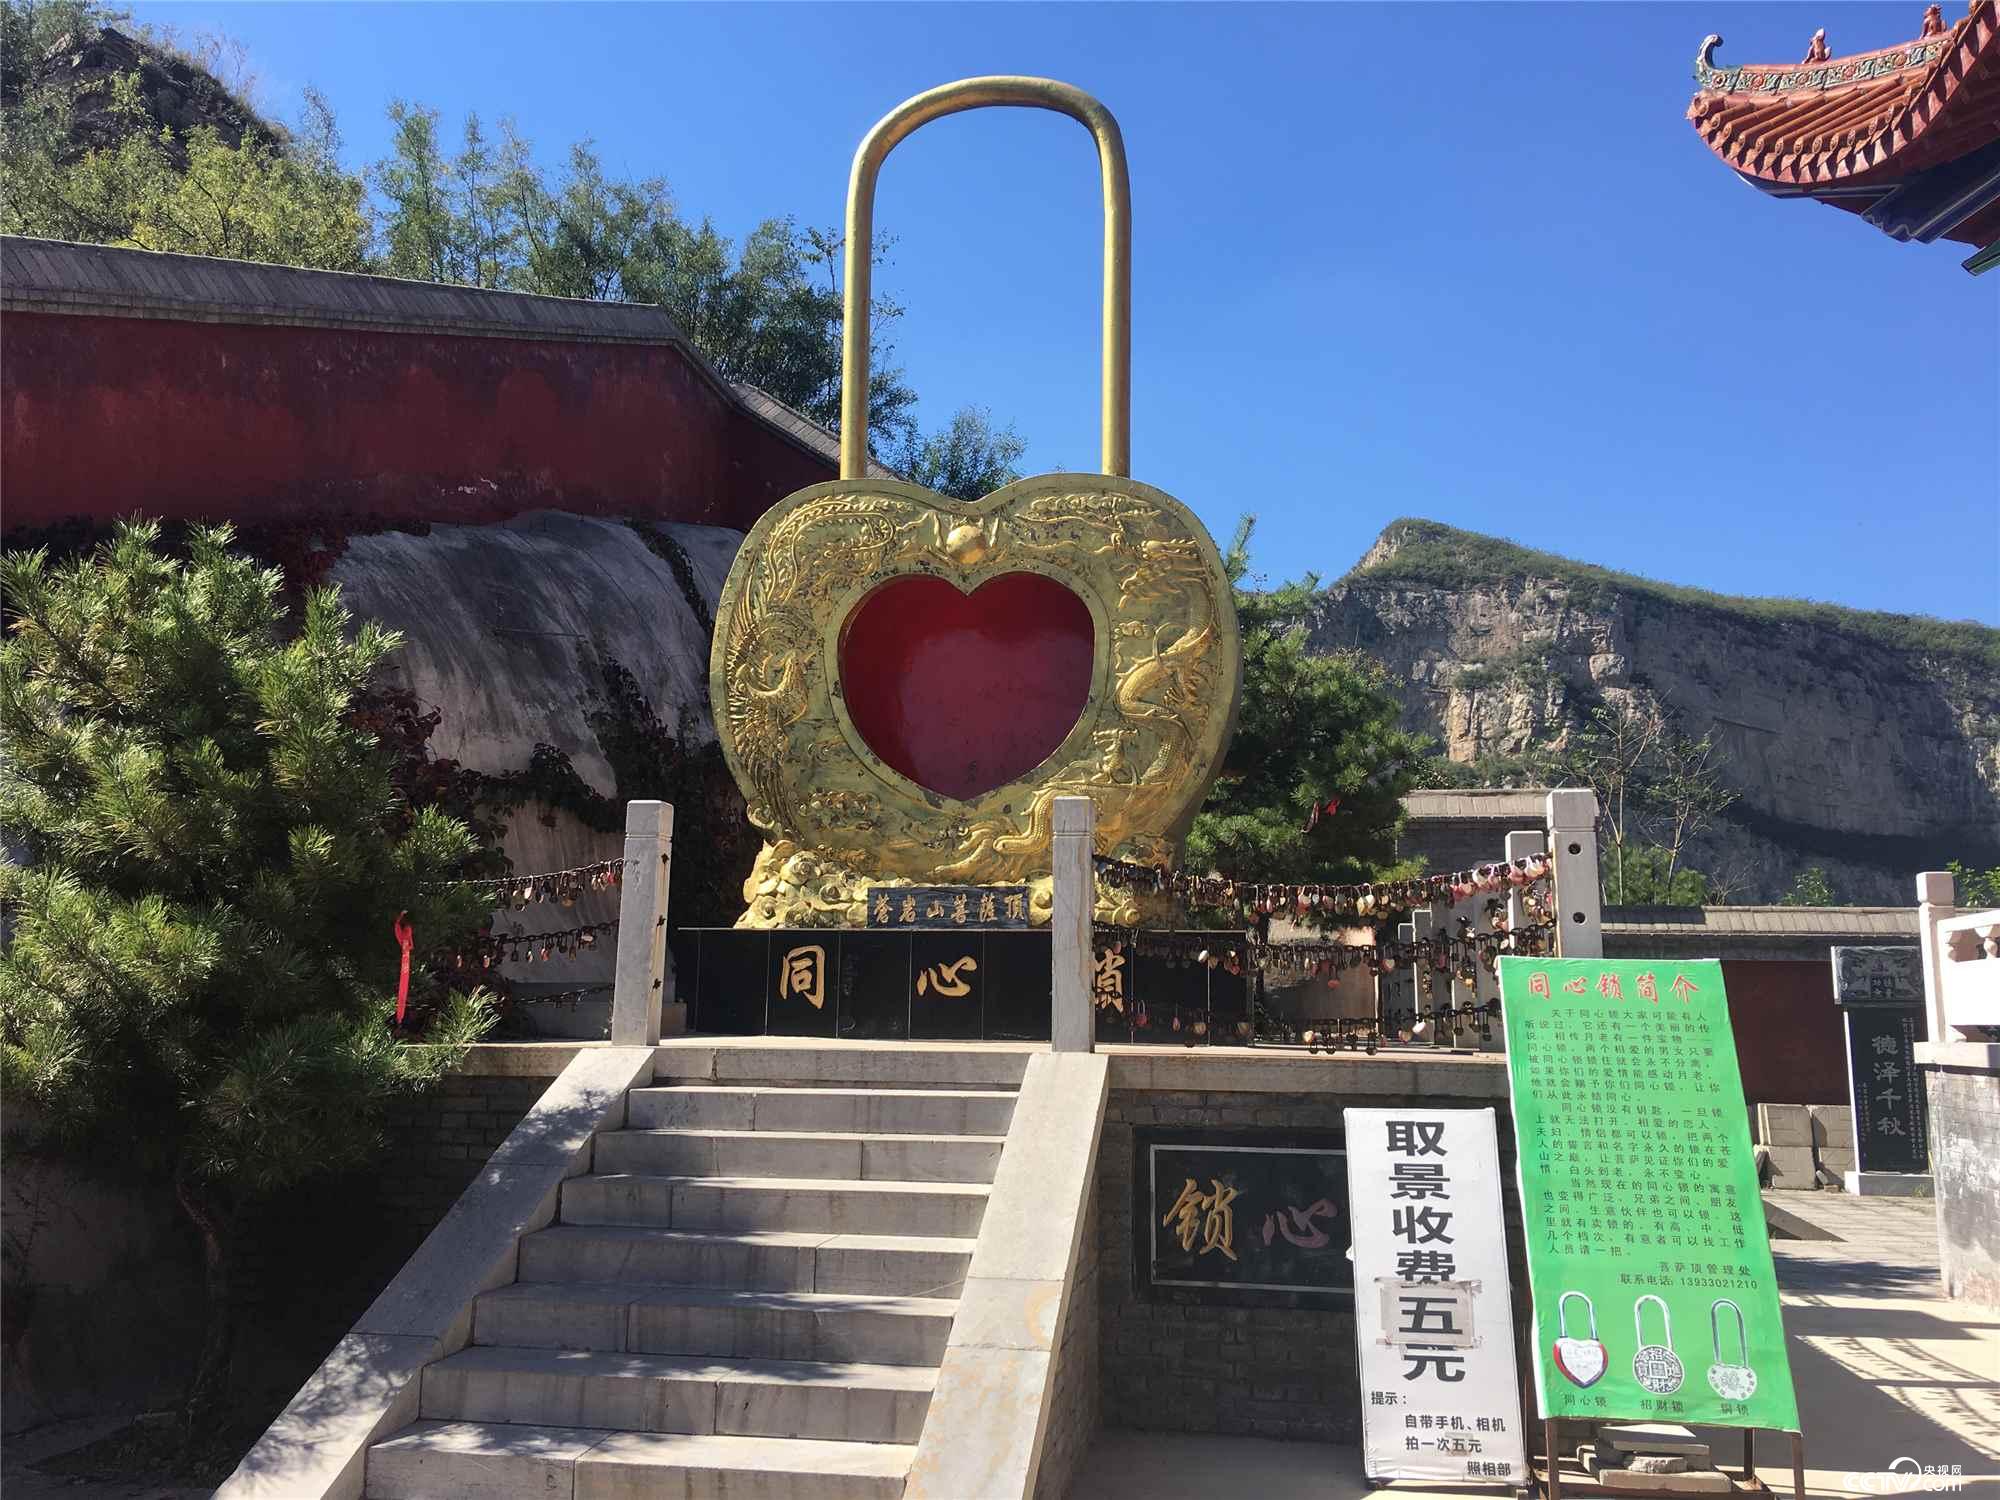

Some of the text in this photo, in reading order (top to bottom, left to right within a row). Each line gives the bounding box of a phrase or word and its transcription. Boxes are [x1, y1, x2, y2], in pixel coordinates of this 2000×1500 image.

[1528, 971, 1700, 1004] 同心锁简介
[1871, 1034, 1906, 1136] 德泽千秋
[1386, 1120, 1466, 1383] 取景收费五元
[1659, 1262, 1751, 1276] 菩萨顶管理处
[1681, 1277, 1758, 1289] 13933021210
[1405, 1414, 1506, 1432] 自带手机、相机
[1405, 1436, 1482, 1453] 拍一次五元
[1467, 1461, 1512, 1477] 照相部
